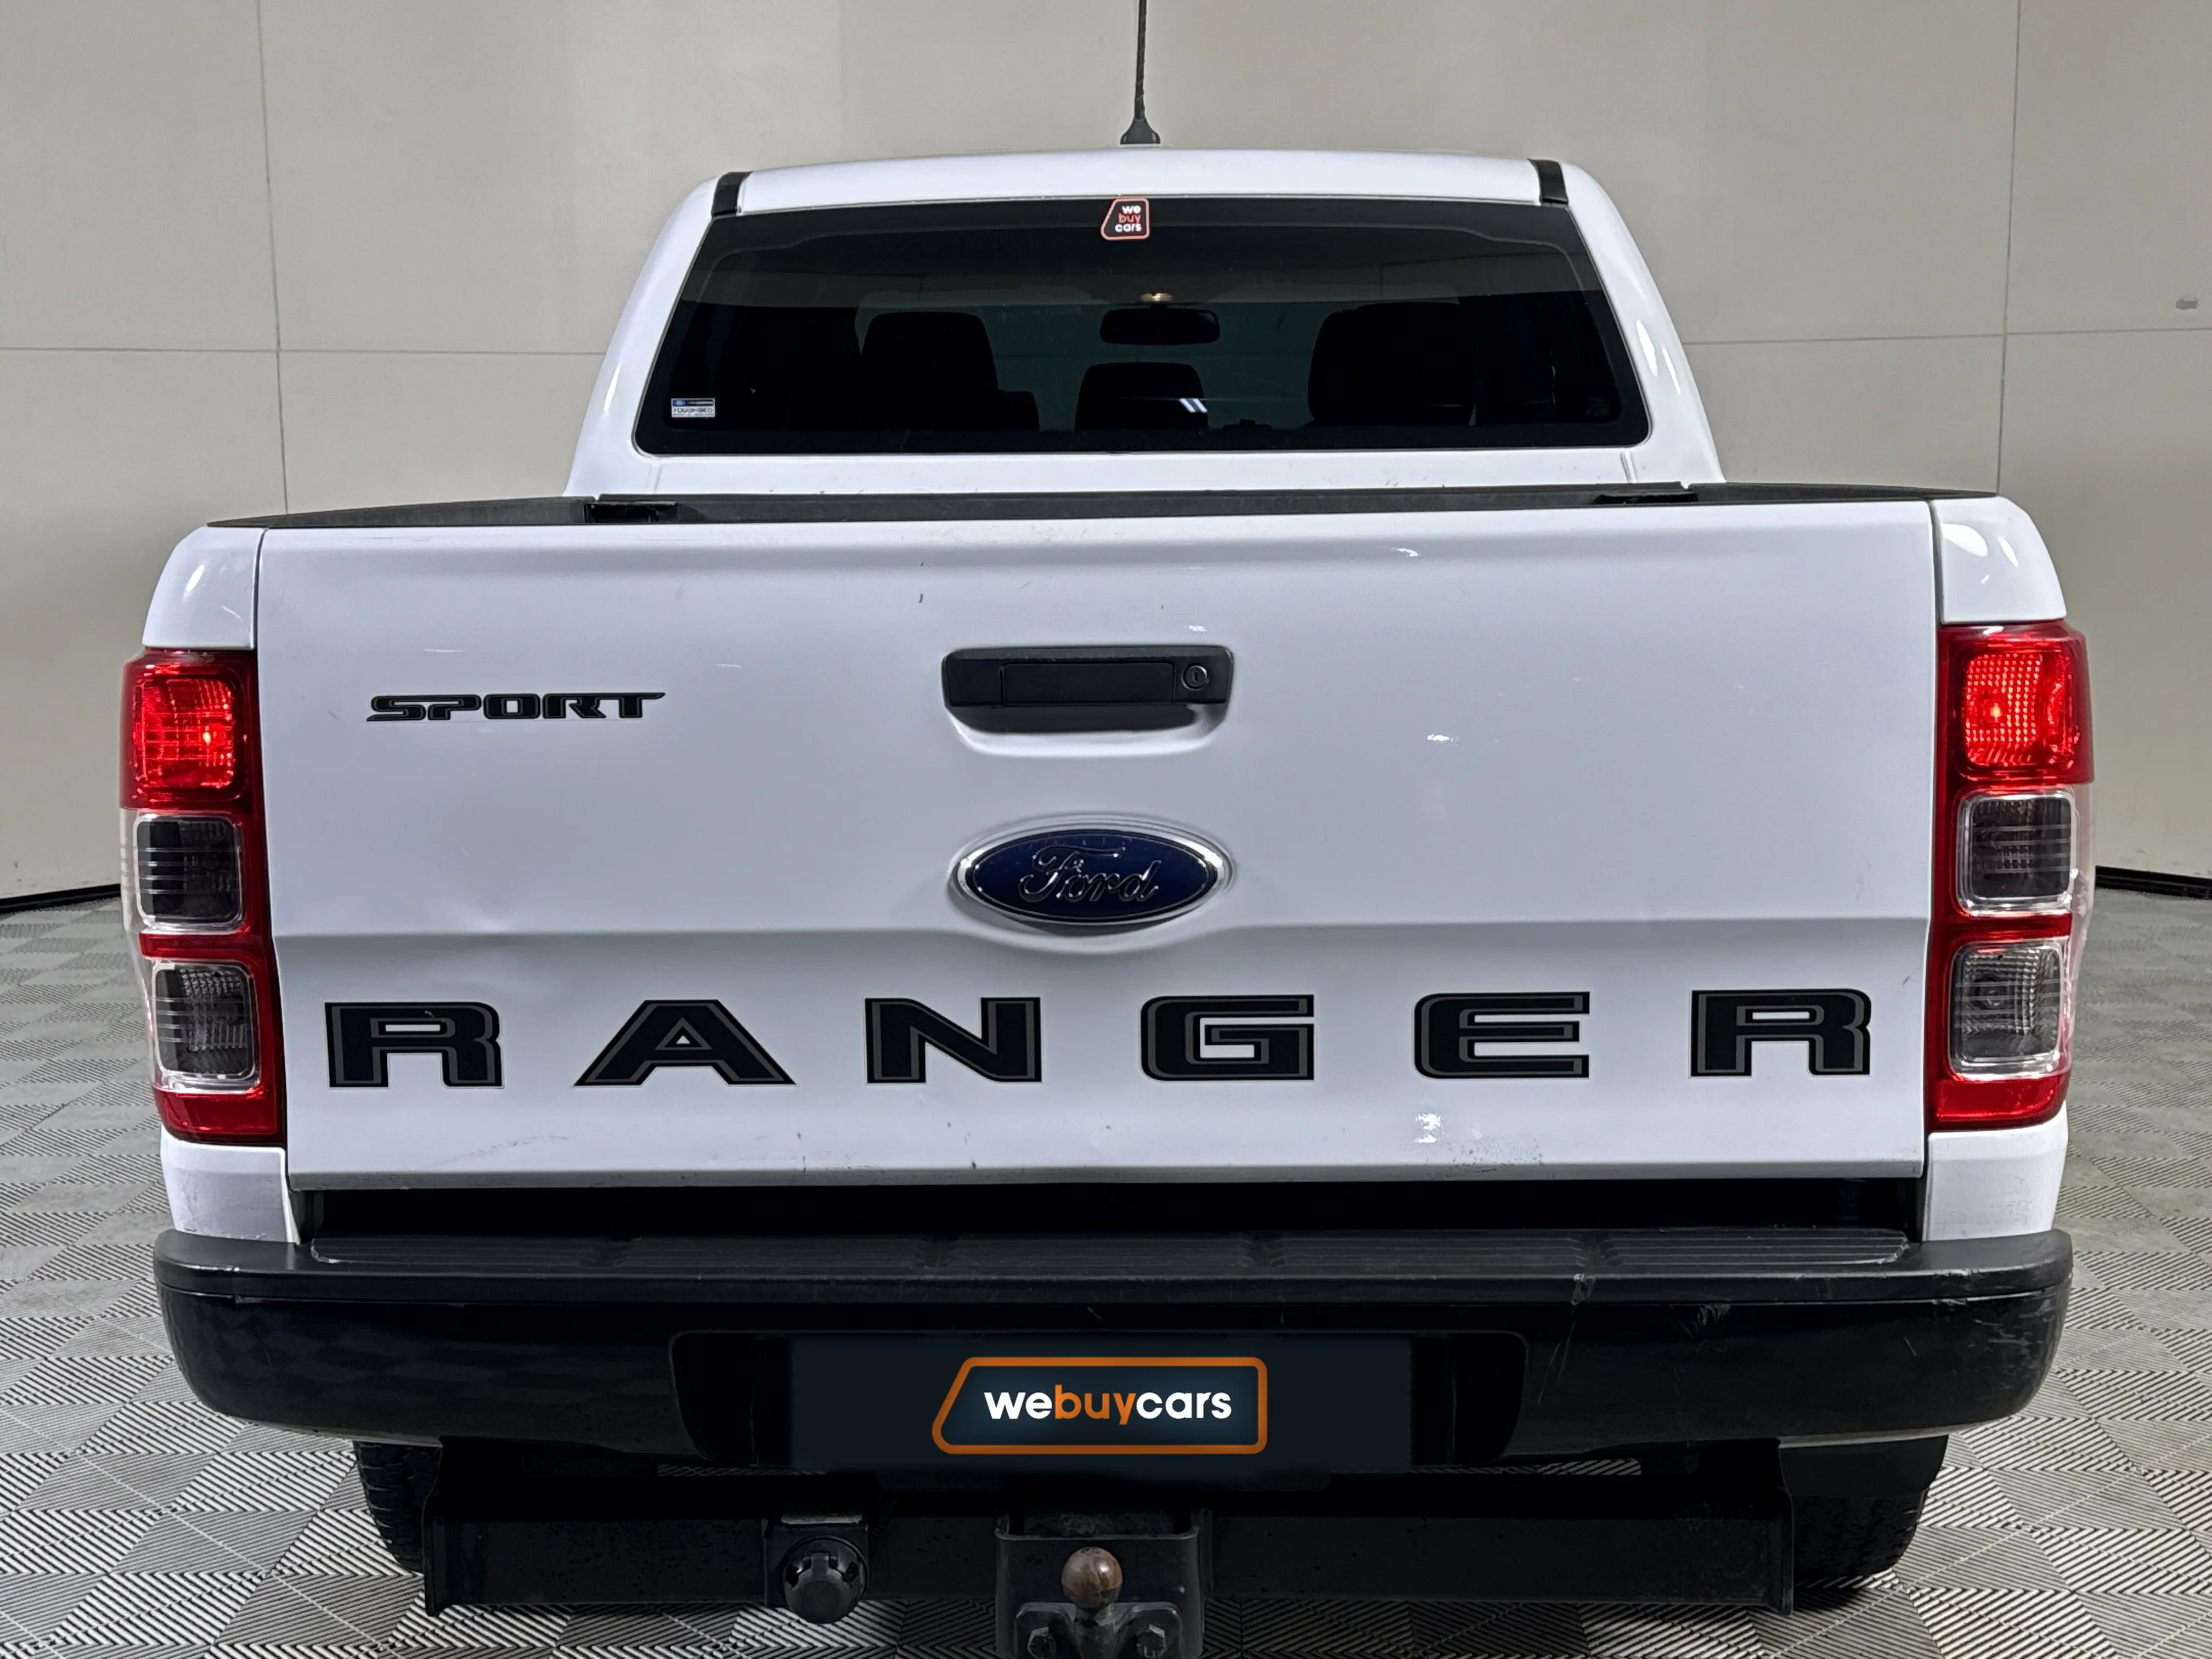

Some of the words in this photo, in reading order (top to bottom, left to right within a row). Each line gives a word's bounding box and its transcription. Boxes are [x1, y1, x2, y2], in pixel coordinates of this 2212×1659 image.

[1115, 223, 1142, 232] cars
[1118, 213, 1141, 223] buy
[366, 692, 665, 721] SPORT
[1018, 845, 1161, 902] Ford
[324, 989, 1871, 1087] RANGER
